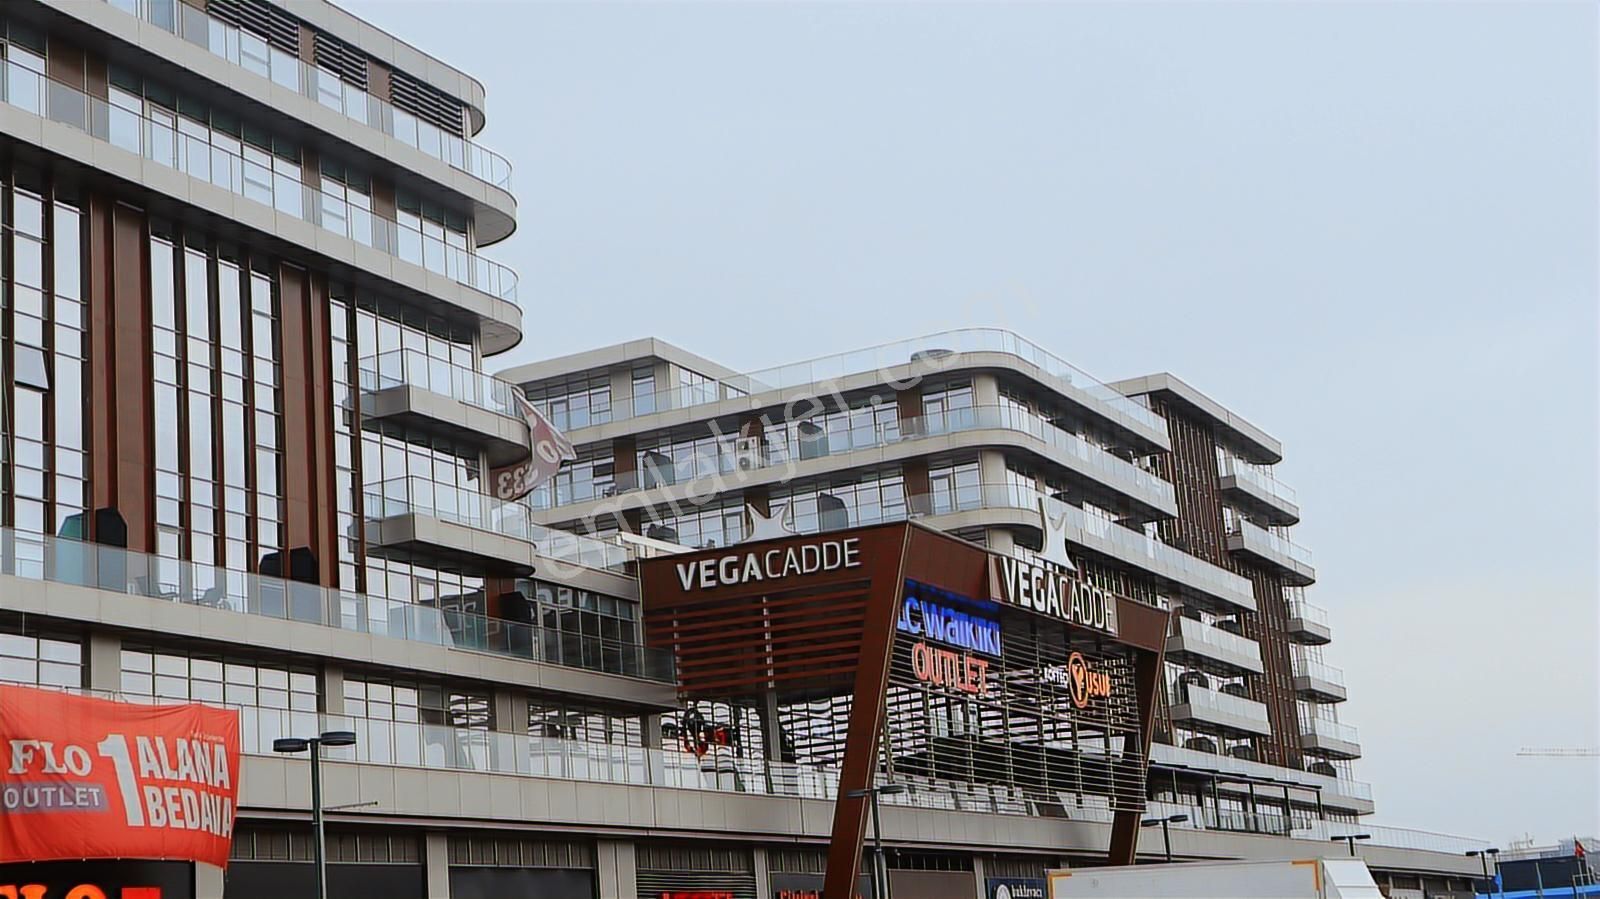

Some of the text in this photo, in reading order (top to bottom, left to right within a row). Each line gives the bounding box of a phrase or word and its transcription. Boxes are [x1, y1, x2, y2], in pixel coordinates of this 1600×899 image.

[676, 538, 862, 591] VEGACADDE
[1002, 556, 1117, 633] VEGACADDE
[911, 642, 988, 695] OUTLET
[8, 740, 92, 777] FLO
[97, 734, 230, 827] 1 ALANA
[4, 787, 100, 809] OUTLET
[143, 785, 232, 840] BEDAVA
